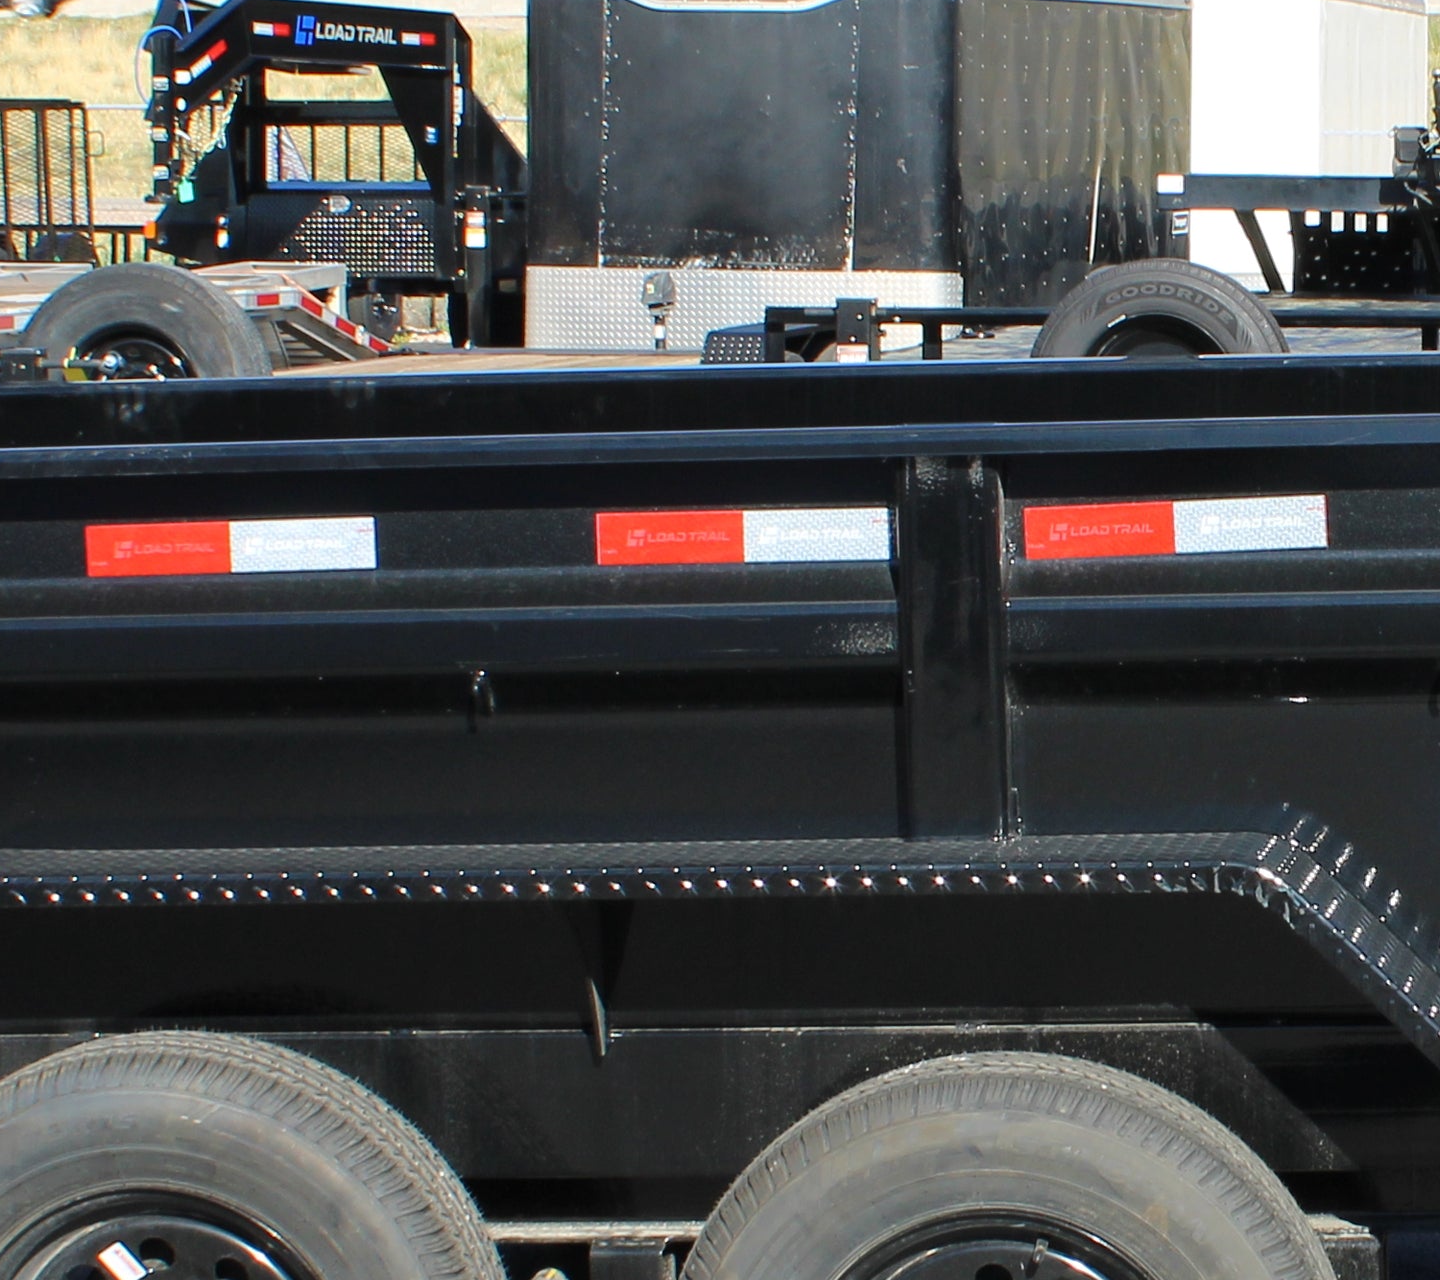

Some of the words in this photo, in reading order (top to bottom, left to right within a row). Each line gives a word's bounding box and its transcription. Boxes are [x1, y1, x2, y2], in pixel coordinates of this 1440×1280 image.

[315, 23, 355, 42] LOAD
[356, 25, 397, 45] TRAIL
[1105, 284, 1236, 325] GOODRIDE
[647, 532, 687, 543] LOAD
[689, 530, 730, 542] TRAIL
[1070, 525, 1110, 537] LOAD
[1112, 523, 1154, 535] TRAIL
